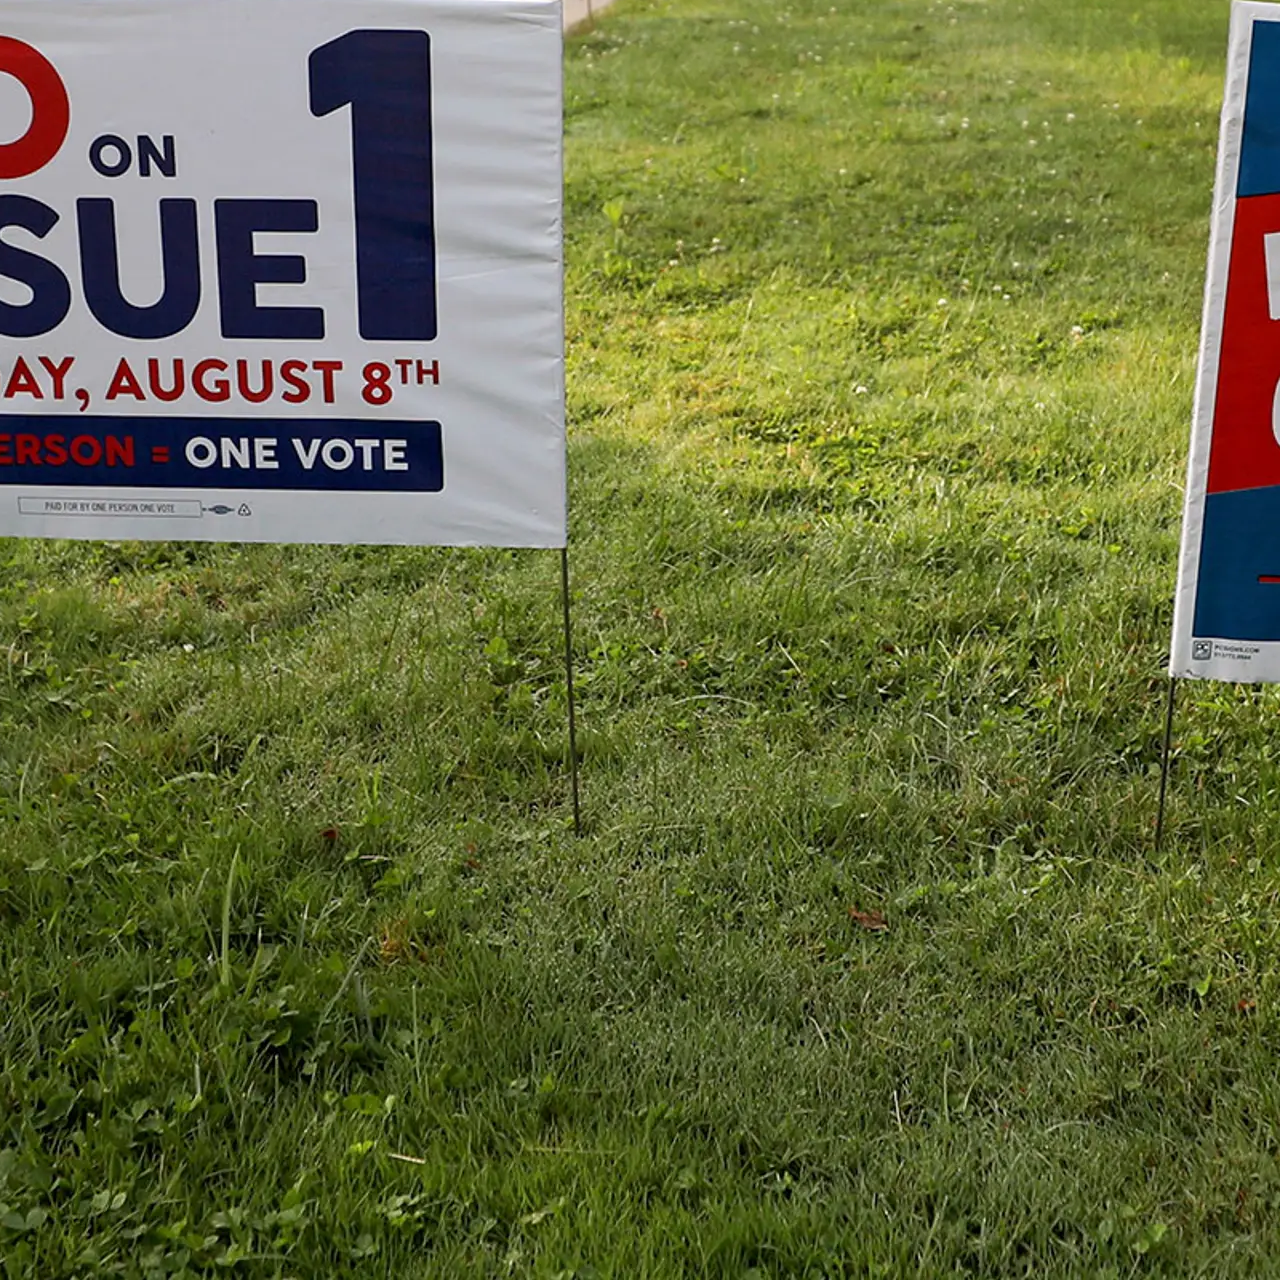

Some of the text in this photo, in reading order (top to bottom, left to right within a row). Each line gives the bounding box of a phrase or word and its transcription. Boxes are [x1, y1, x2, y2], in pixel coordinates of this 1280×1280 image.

[89, 134, 176, 178] ON
[308, 28, 438, 341] 1
[105, 357, 343, 404] AUGUST
[361, 359, 440, 406] 8TH
[185, 436, 279, 469] ONE
[292, 438, 409, 471] VOTE
[45, 501, 175, 513] PAID FOR BY ONE PERSON ONE VOTE
